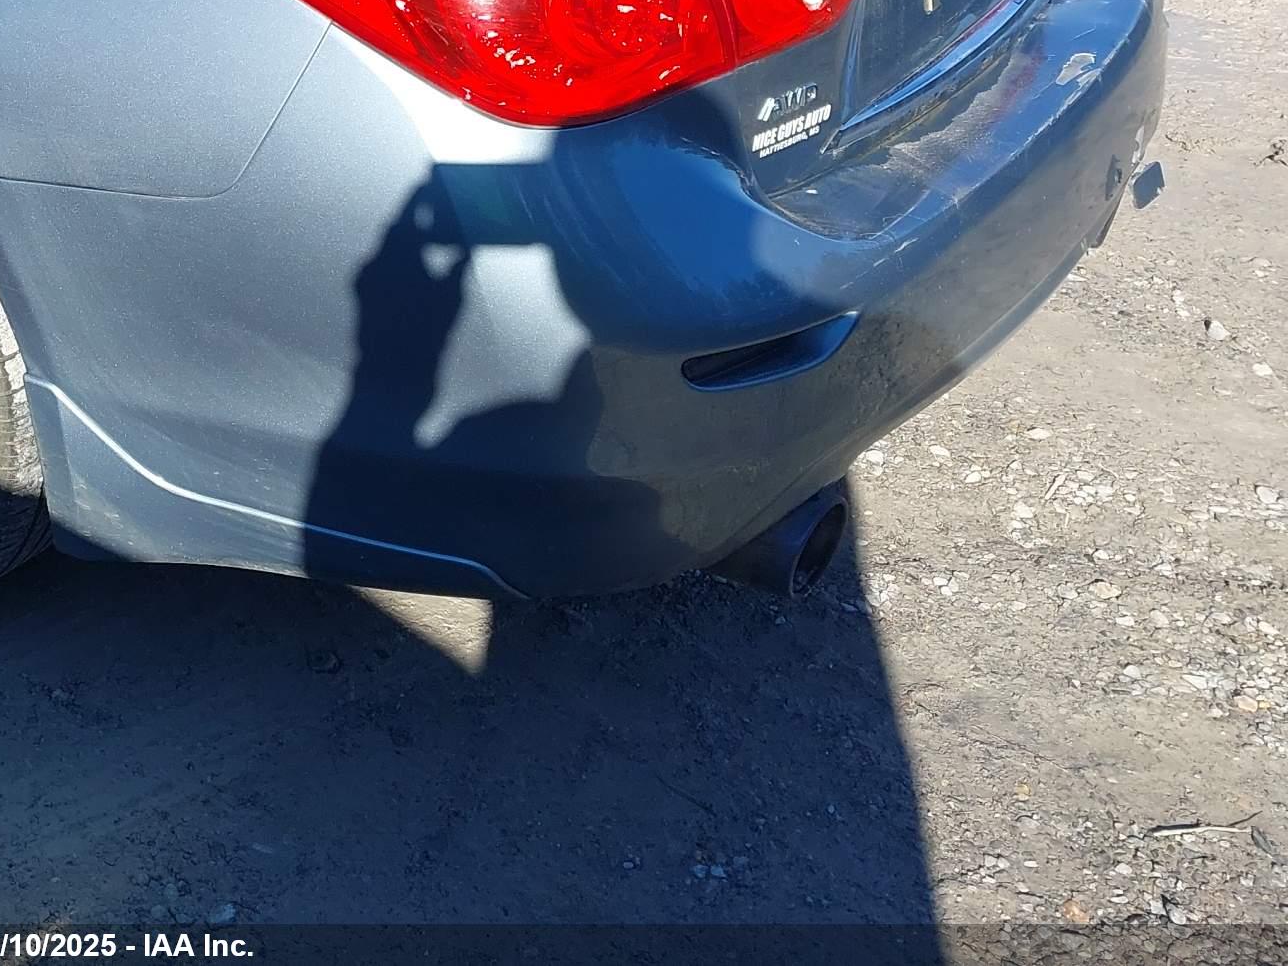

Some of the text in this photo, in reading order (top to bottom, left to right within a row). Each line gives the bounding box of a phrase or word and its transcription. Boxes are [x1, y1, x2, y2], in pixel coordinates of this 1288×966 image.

[752, 104, 832, 152] NICE GUYS AUTO
